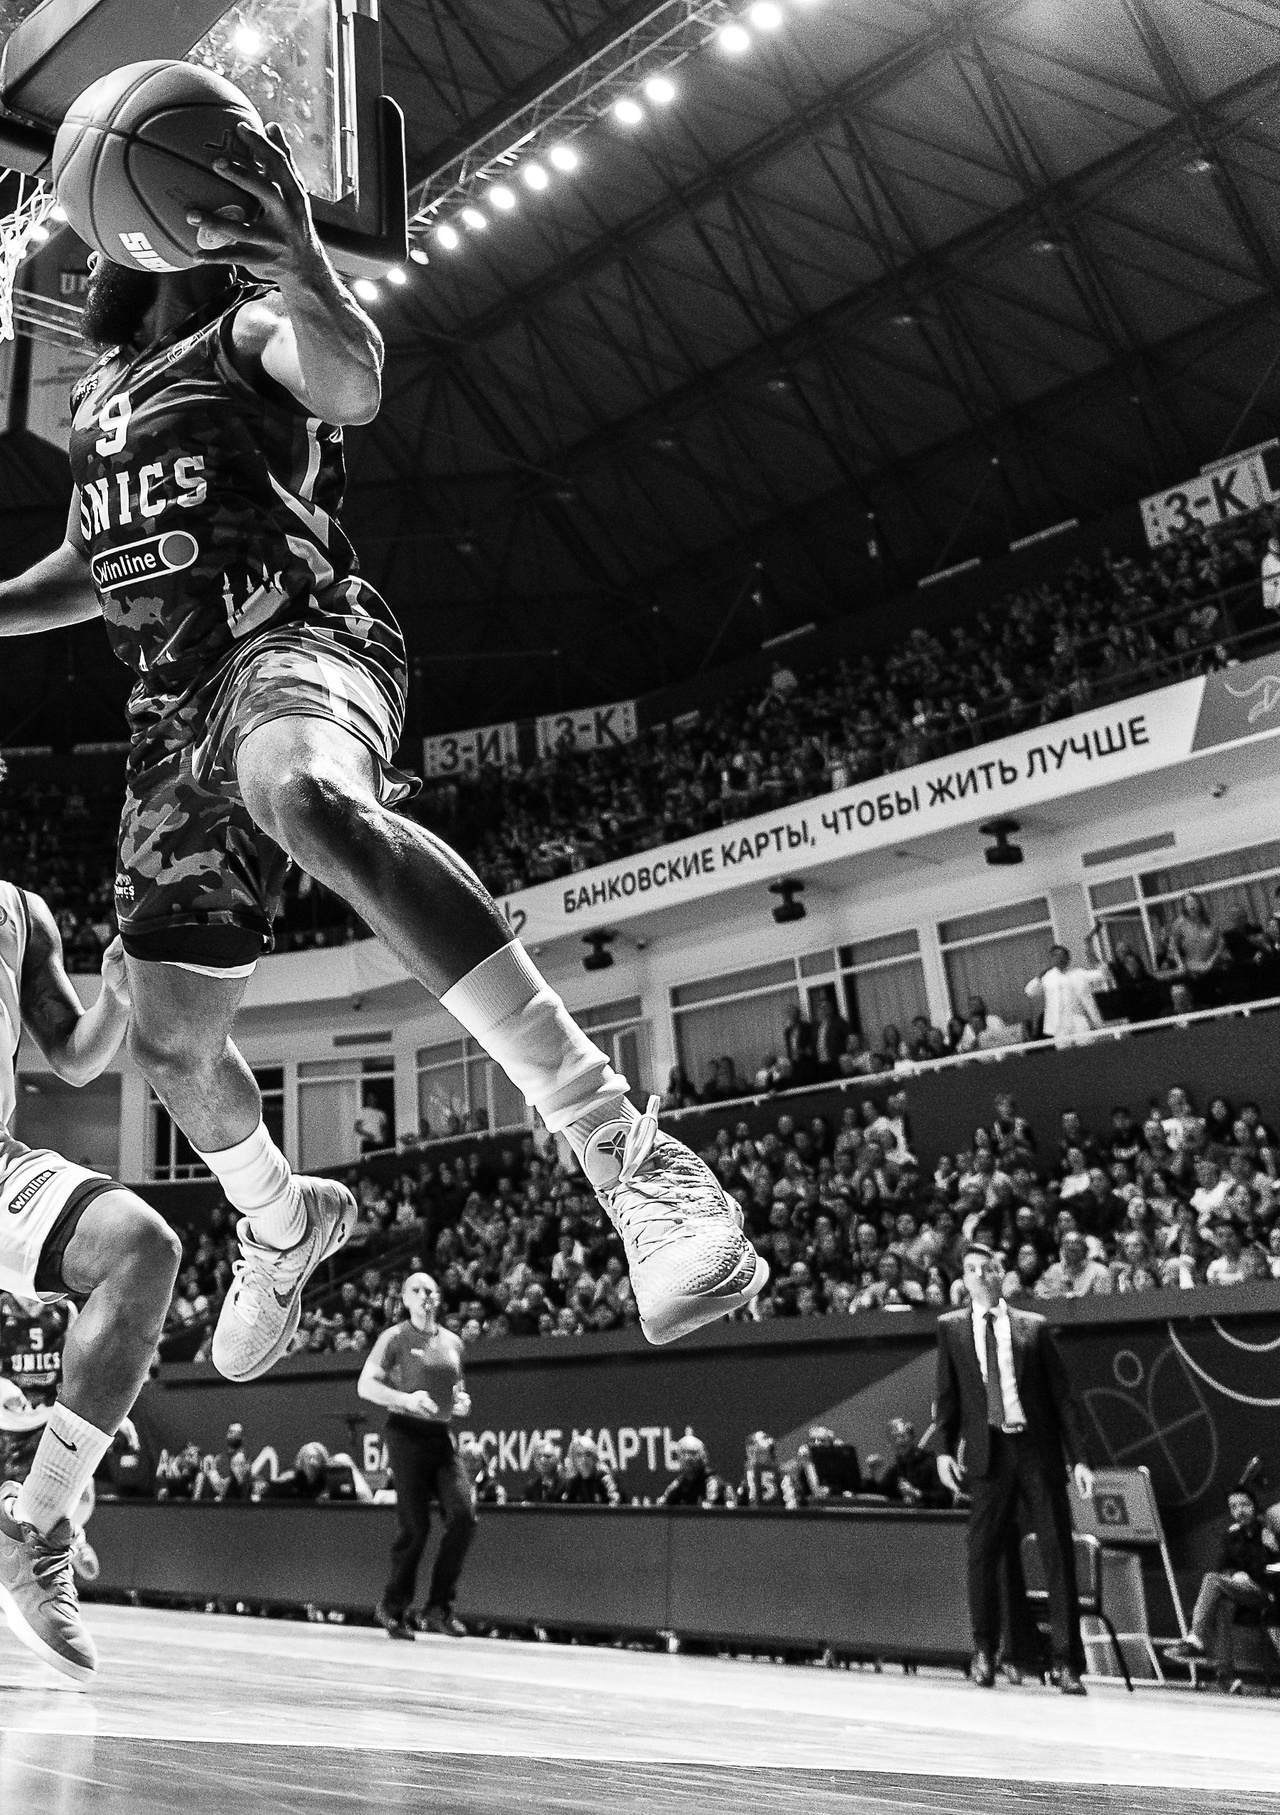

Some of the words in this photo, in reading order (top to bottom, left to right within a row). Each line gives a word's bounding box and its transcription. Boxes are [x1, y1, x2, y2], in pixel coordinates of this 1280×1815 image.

[96, 391, 132, 457] 9
[96, 552, 157, 584] Winline
[564, 847, 715, 914] БАНКОВСКИЕ
[721, 820, 817, 867] КАРТЫ,
[822, 785, 920, 835] ЧТОБЫ
[927, 758, 1018, 806] ЖИТЬ
[1027, 715, 1150, 777] ЛУЧШЕ
[11, 1351, 61, 1372] UNICS
